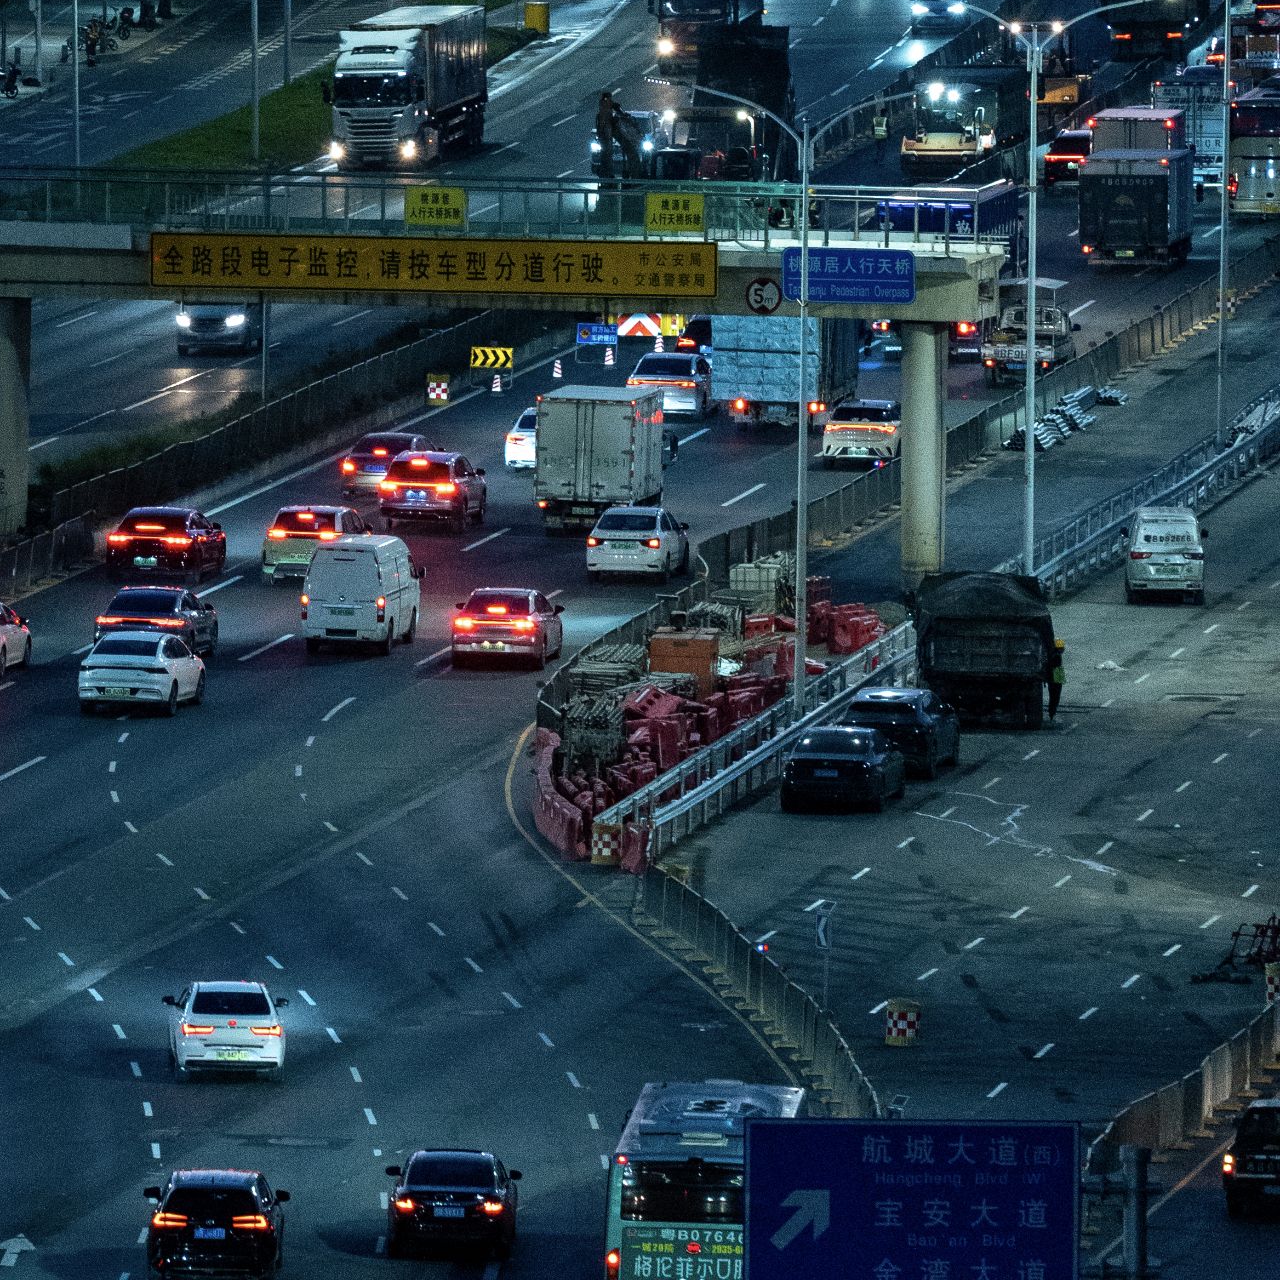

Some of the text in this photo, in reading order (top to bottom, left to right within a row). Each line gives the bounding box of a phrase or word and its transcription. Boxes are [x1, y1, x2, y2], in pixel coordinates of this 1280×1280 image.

[420, 193, 450, 206] 桃源居
[660, 198, 691, 211] 桃源居
[638, 253, 703, 269] 市公安局
[788, 256, 911, 276] 桃源居人行天桥
[633, 272, 706, 289] 交通警察局
[830, 284, 870, 297] Pedestrian
[874, 285, 910, 300] Overpass
[861, 1134, 1061, 1167] 航城大道(西)
[875, 1172, 962, 1187] Hangcheng
[974, 1172, 1009, 1186] Blvd
[874, 1198, 1049, 1229] 宝安大道
[982, 1233, 1016, 1247] Blvd
[873, 1257, 1049, 1280] 金湾大道
